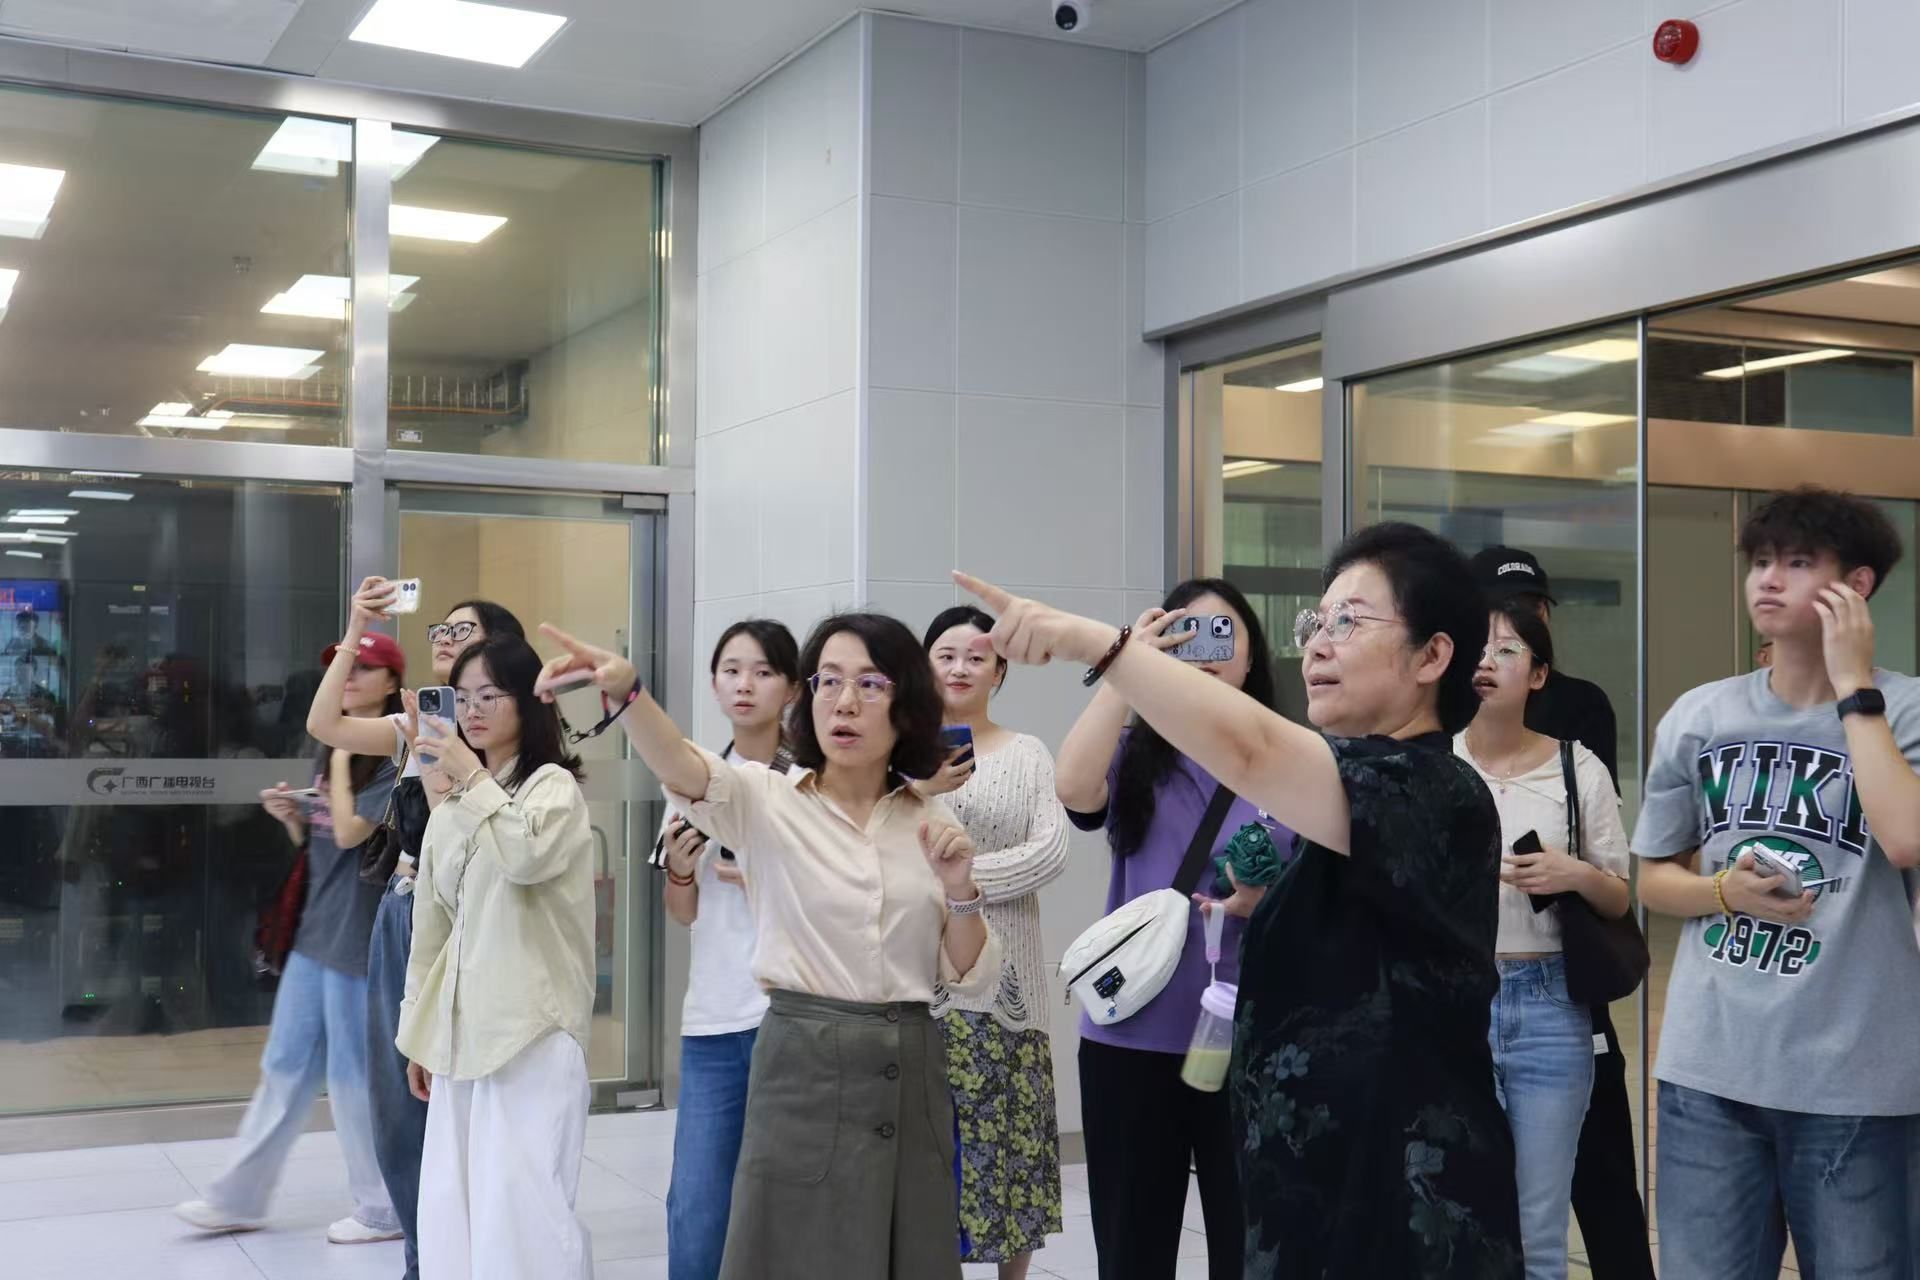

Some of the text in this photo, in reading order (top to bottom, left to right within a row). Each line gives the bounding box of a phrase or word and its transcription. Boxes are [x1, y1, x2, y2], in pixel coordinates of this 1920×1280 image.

[122, 776, 216, 789] 广西广播电视台
[1708, 914, 1814, 977] 1972
